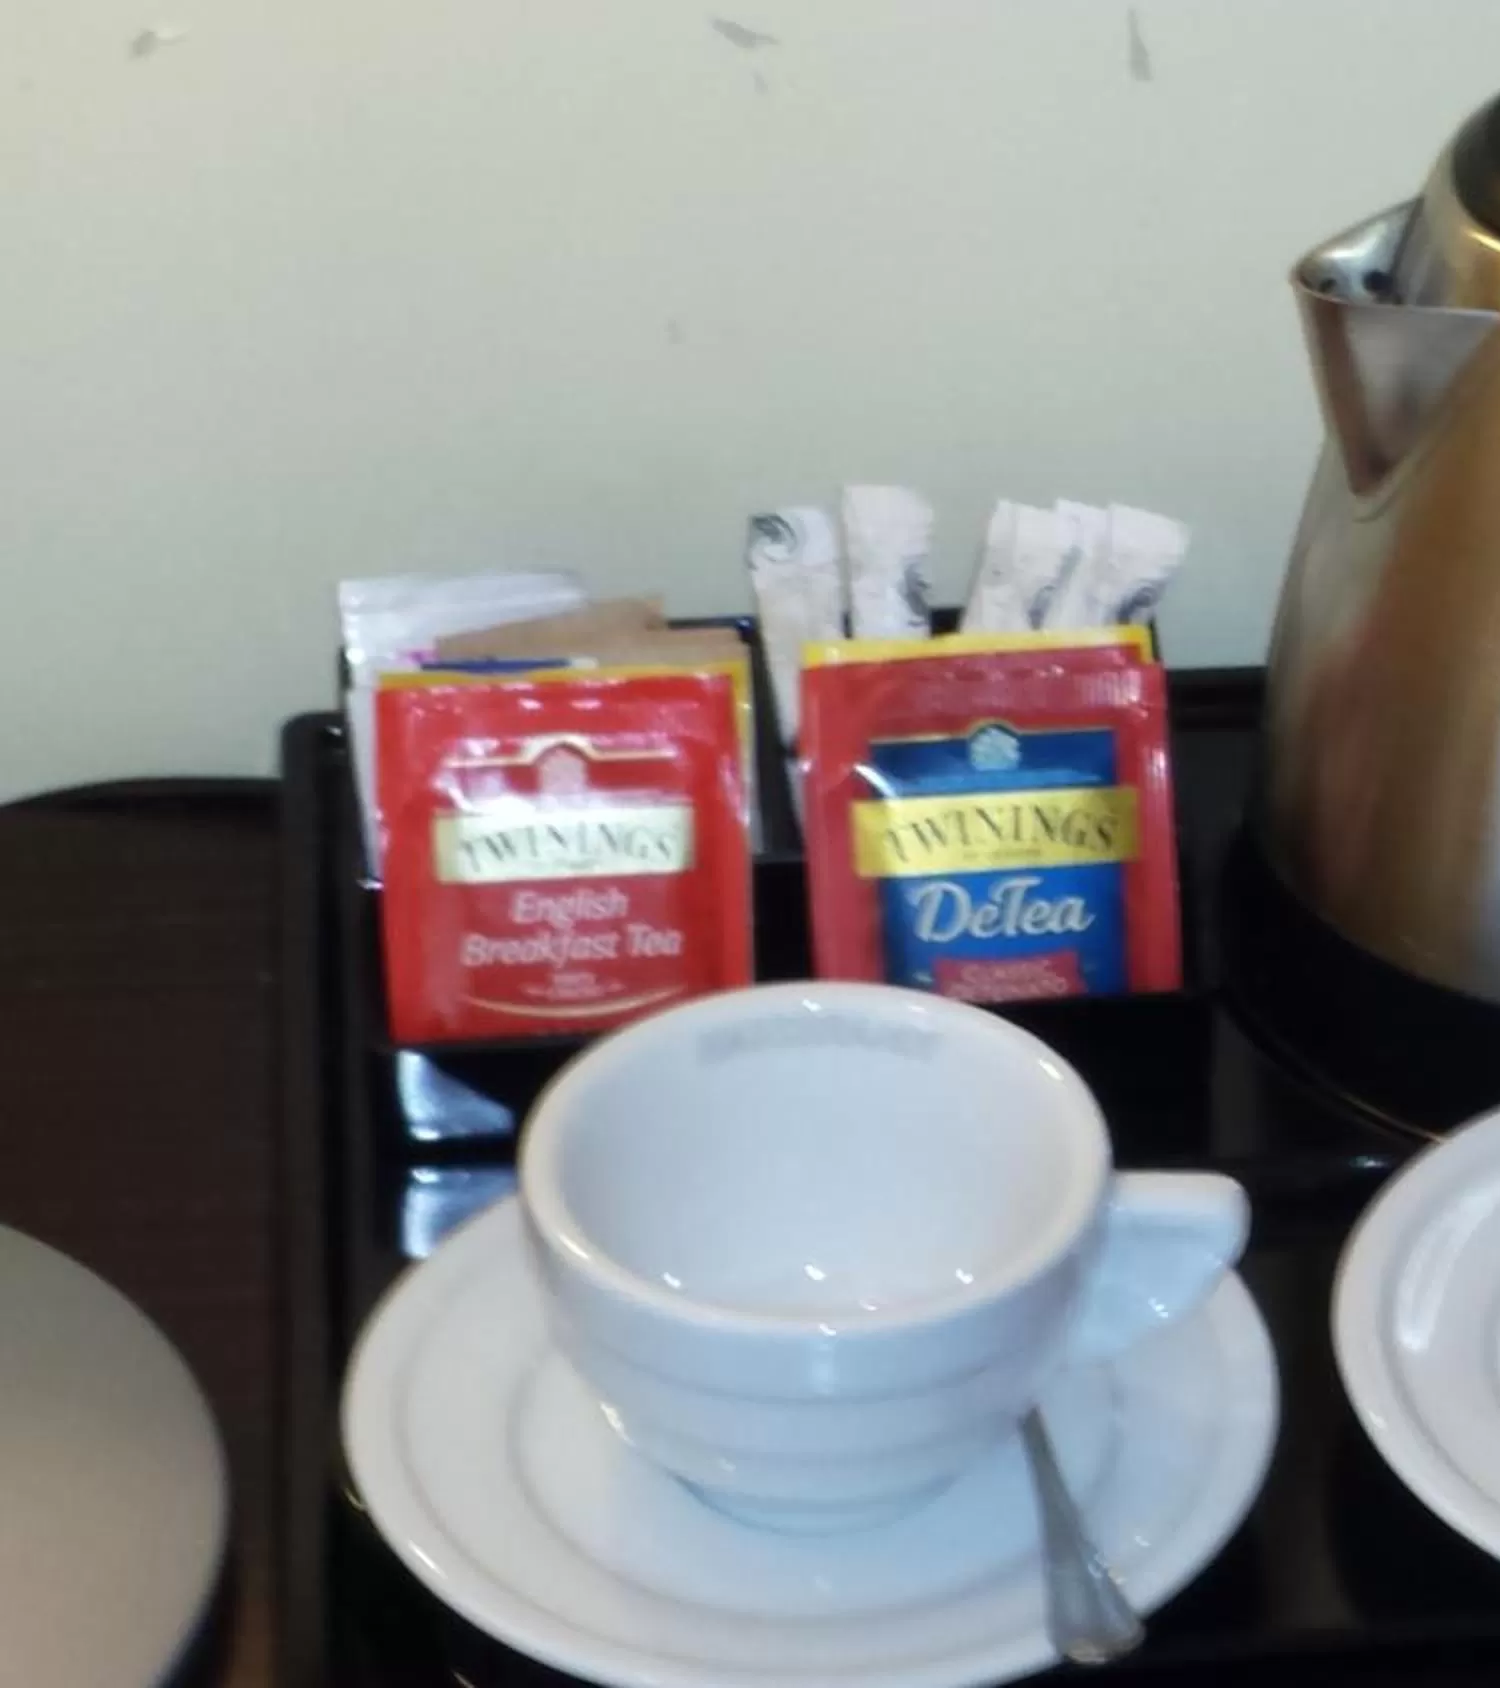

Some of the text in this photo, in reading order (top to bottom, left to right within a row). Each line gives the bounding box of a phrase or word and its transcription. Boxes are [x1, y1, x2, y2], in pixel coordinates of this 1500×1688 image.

[457, 819, 674, 873] TWININGS
[885, 802, 1122, 862] TWININGS
[510, 885, 629, 930] English
[905, 875, 1095, 943] DeTea
[459, 921, 684, 969] Breakfast Tea
